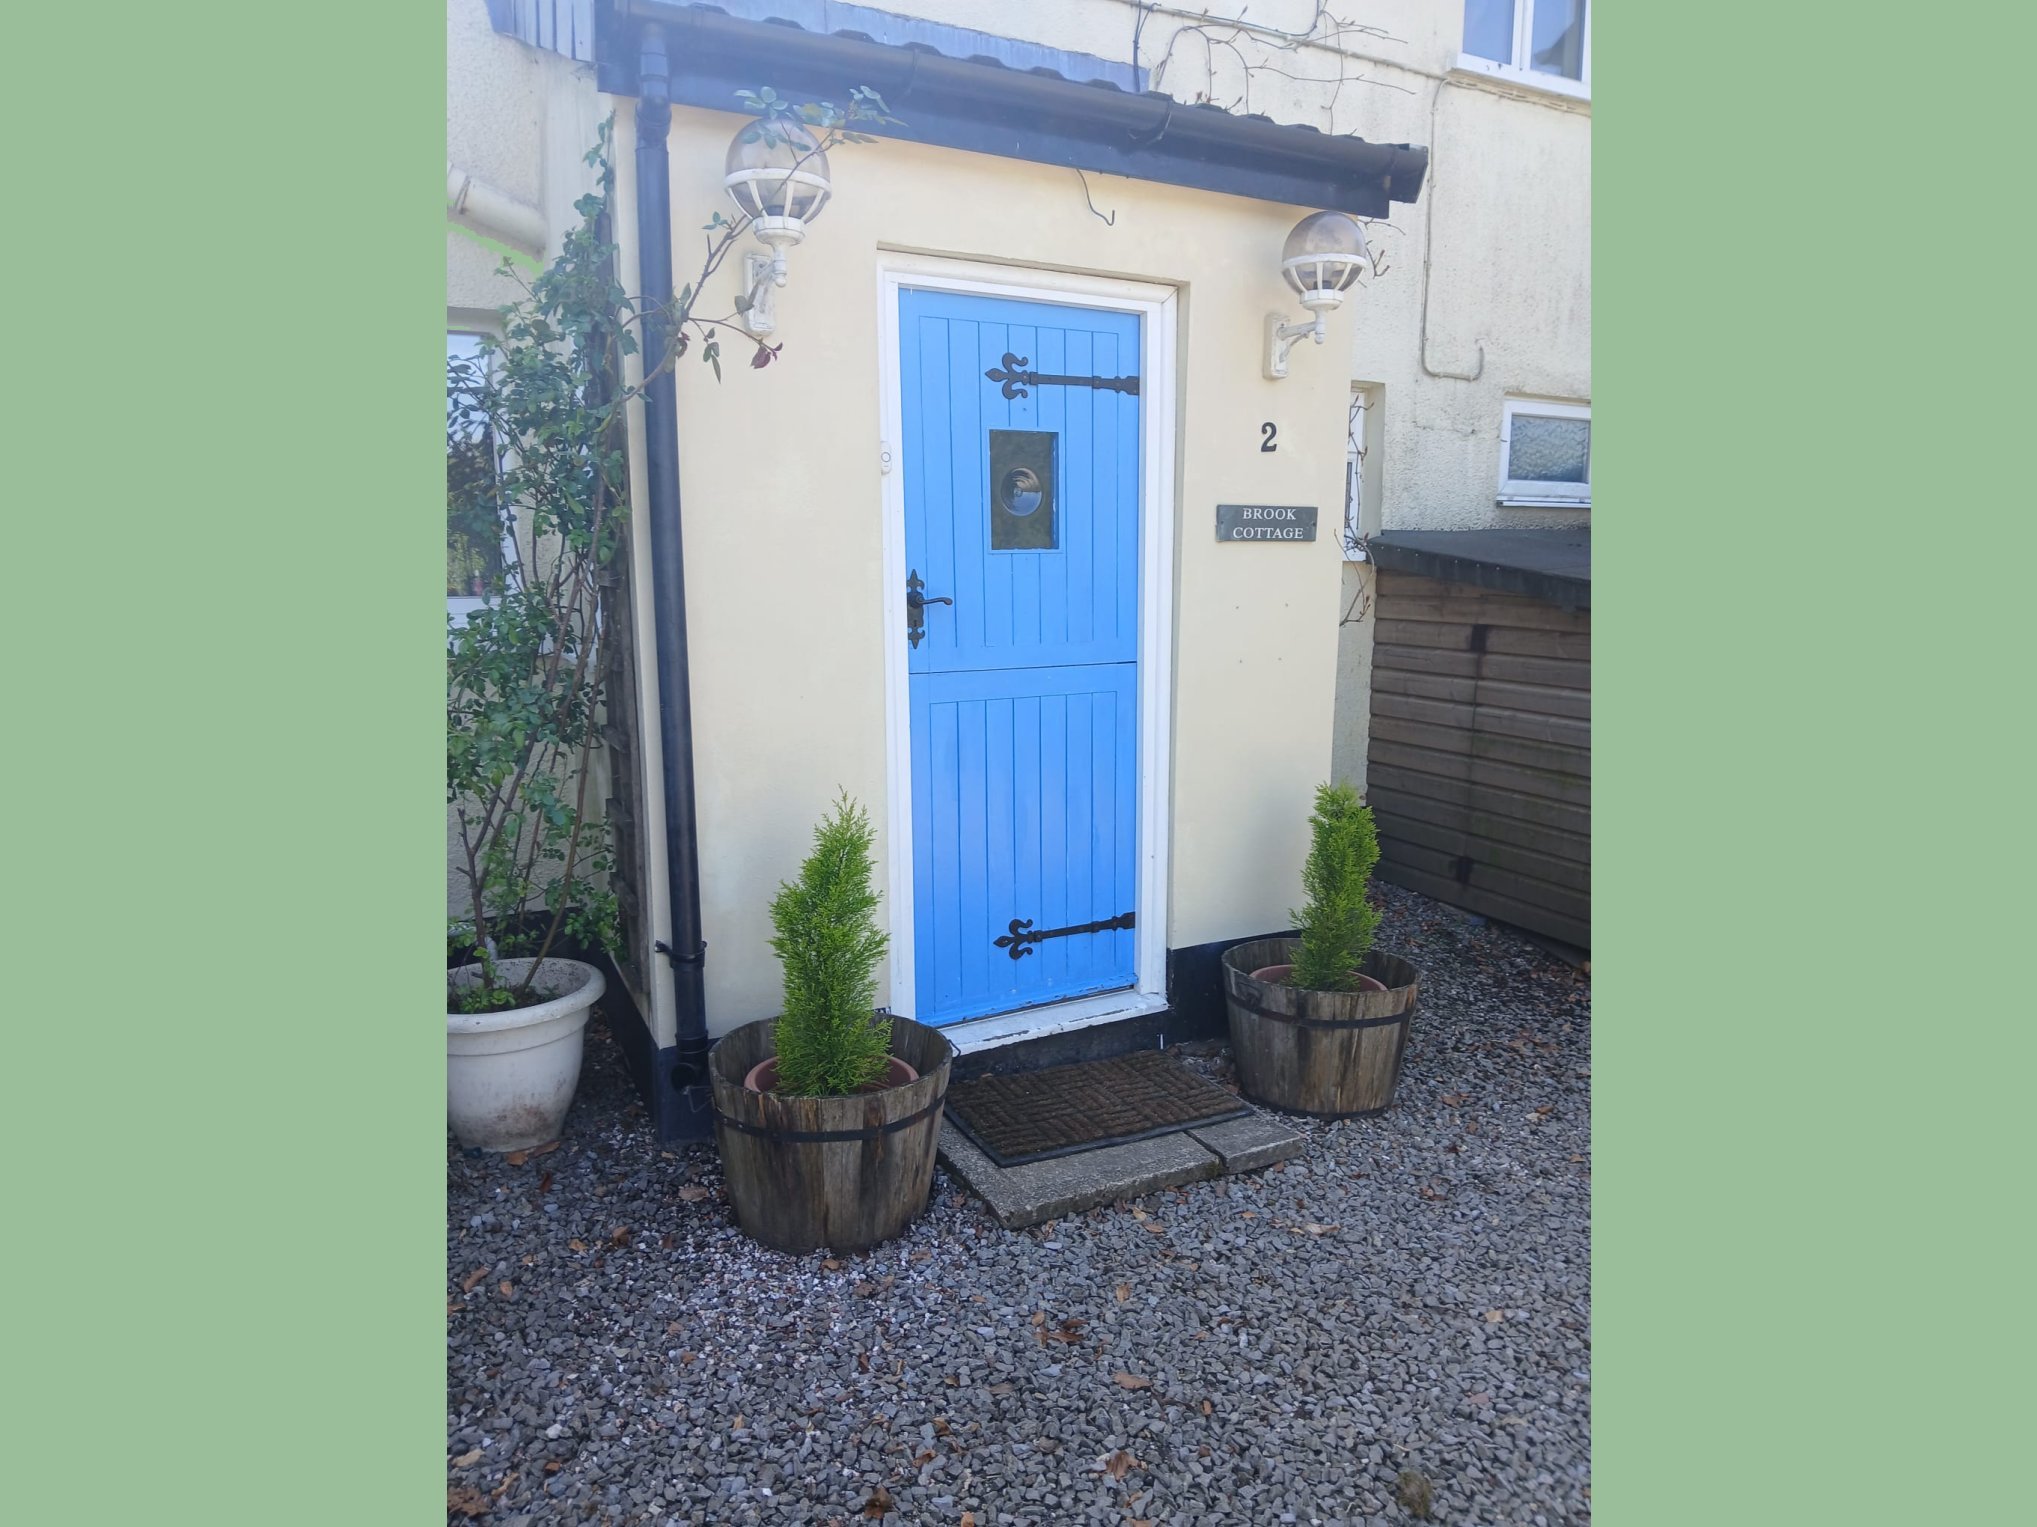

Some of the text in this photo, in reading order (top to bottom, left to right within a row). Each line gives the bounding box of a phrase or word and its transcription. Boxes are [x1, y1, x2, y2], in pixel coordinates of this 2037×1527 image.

[1260, 421, 1278, 453] 2
[1242, 507, 1297, 520] BROOK
[1232, 526, 1304, 539] COTTAGE
